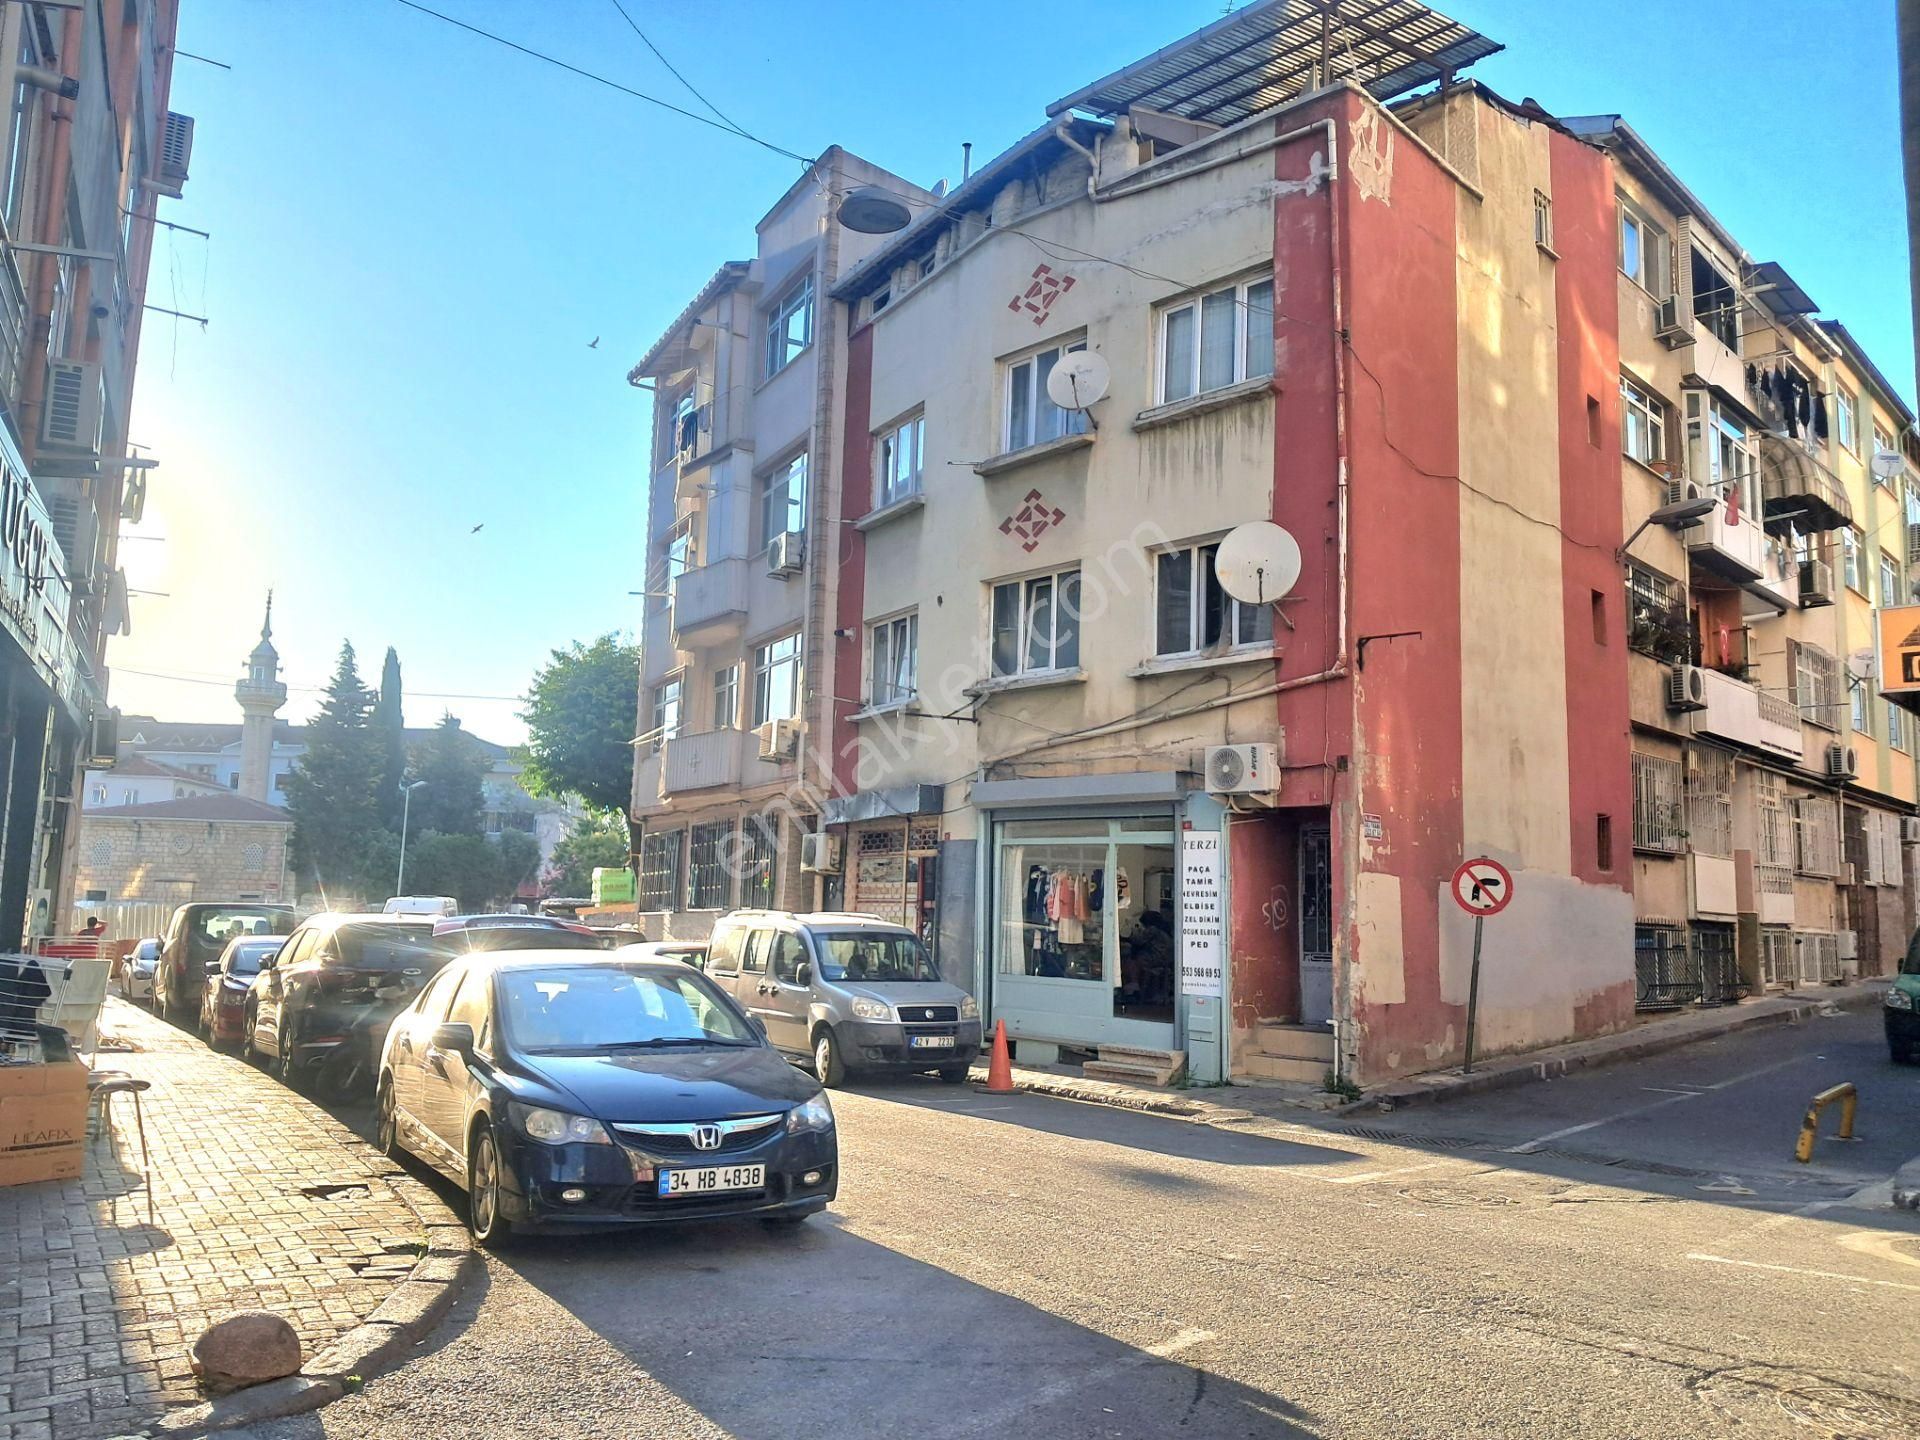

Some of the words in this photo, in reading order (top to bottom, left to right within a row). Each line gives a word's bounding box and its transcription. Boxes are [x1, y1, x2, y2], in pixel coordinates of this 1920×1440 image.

[1183, 837, 1217, 850] TERZİ
[1188, 866, 1210, 875] PAÇA
[1185, 877, 1213, 885] TAMİR
[1184, 902, 1215, 910] ELBİSE
[1182, 928, 1198, 936] OCUK
[1190, 941, 1209, 949] PED
[671, 1172, 689, 1190] 34
[697, 1170, 717, 1189] HB
[723, 1167, 761, 1187] 4838
